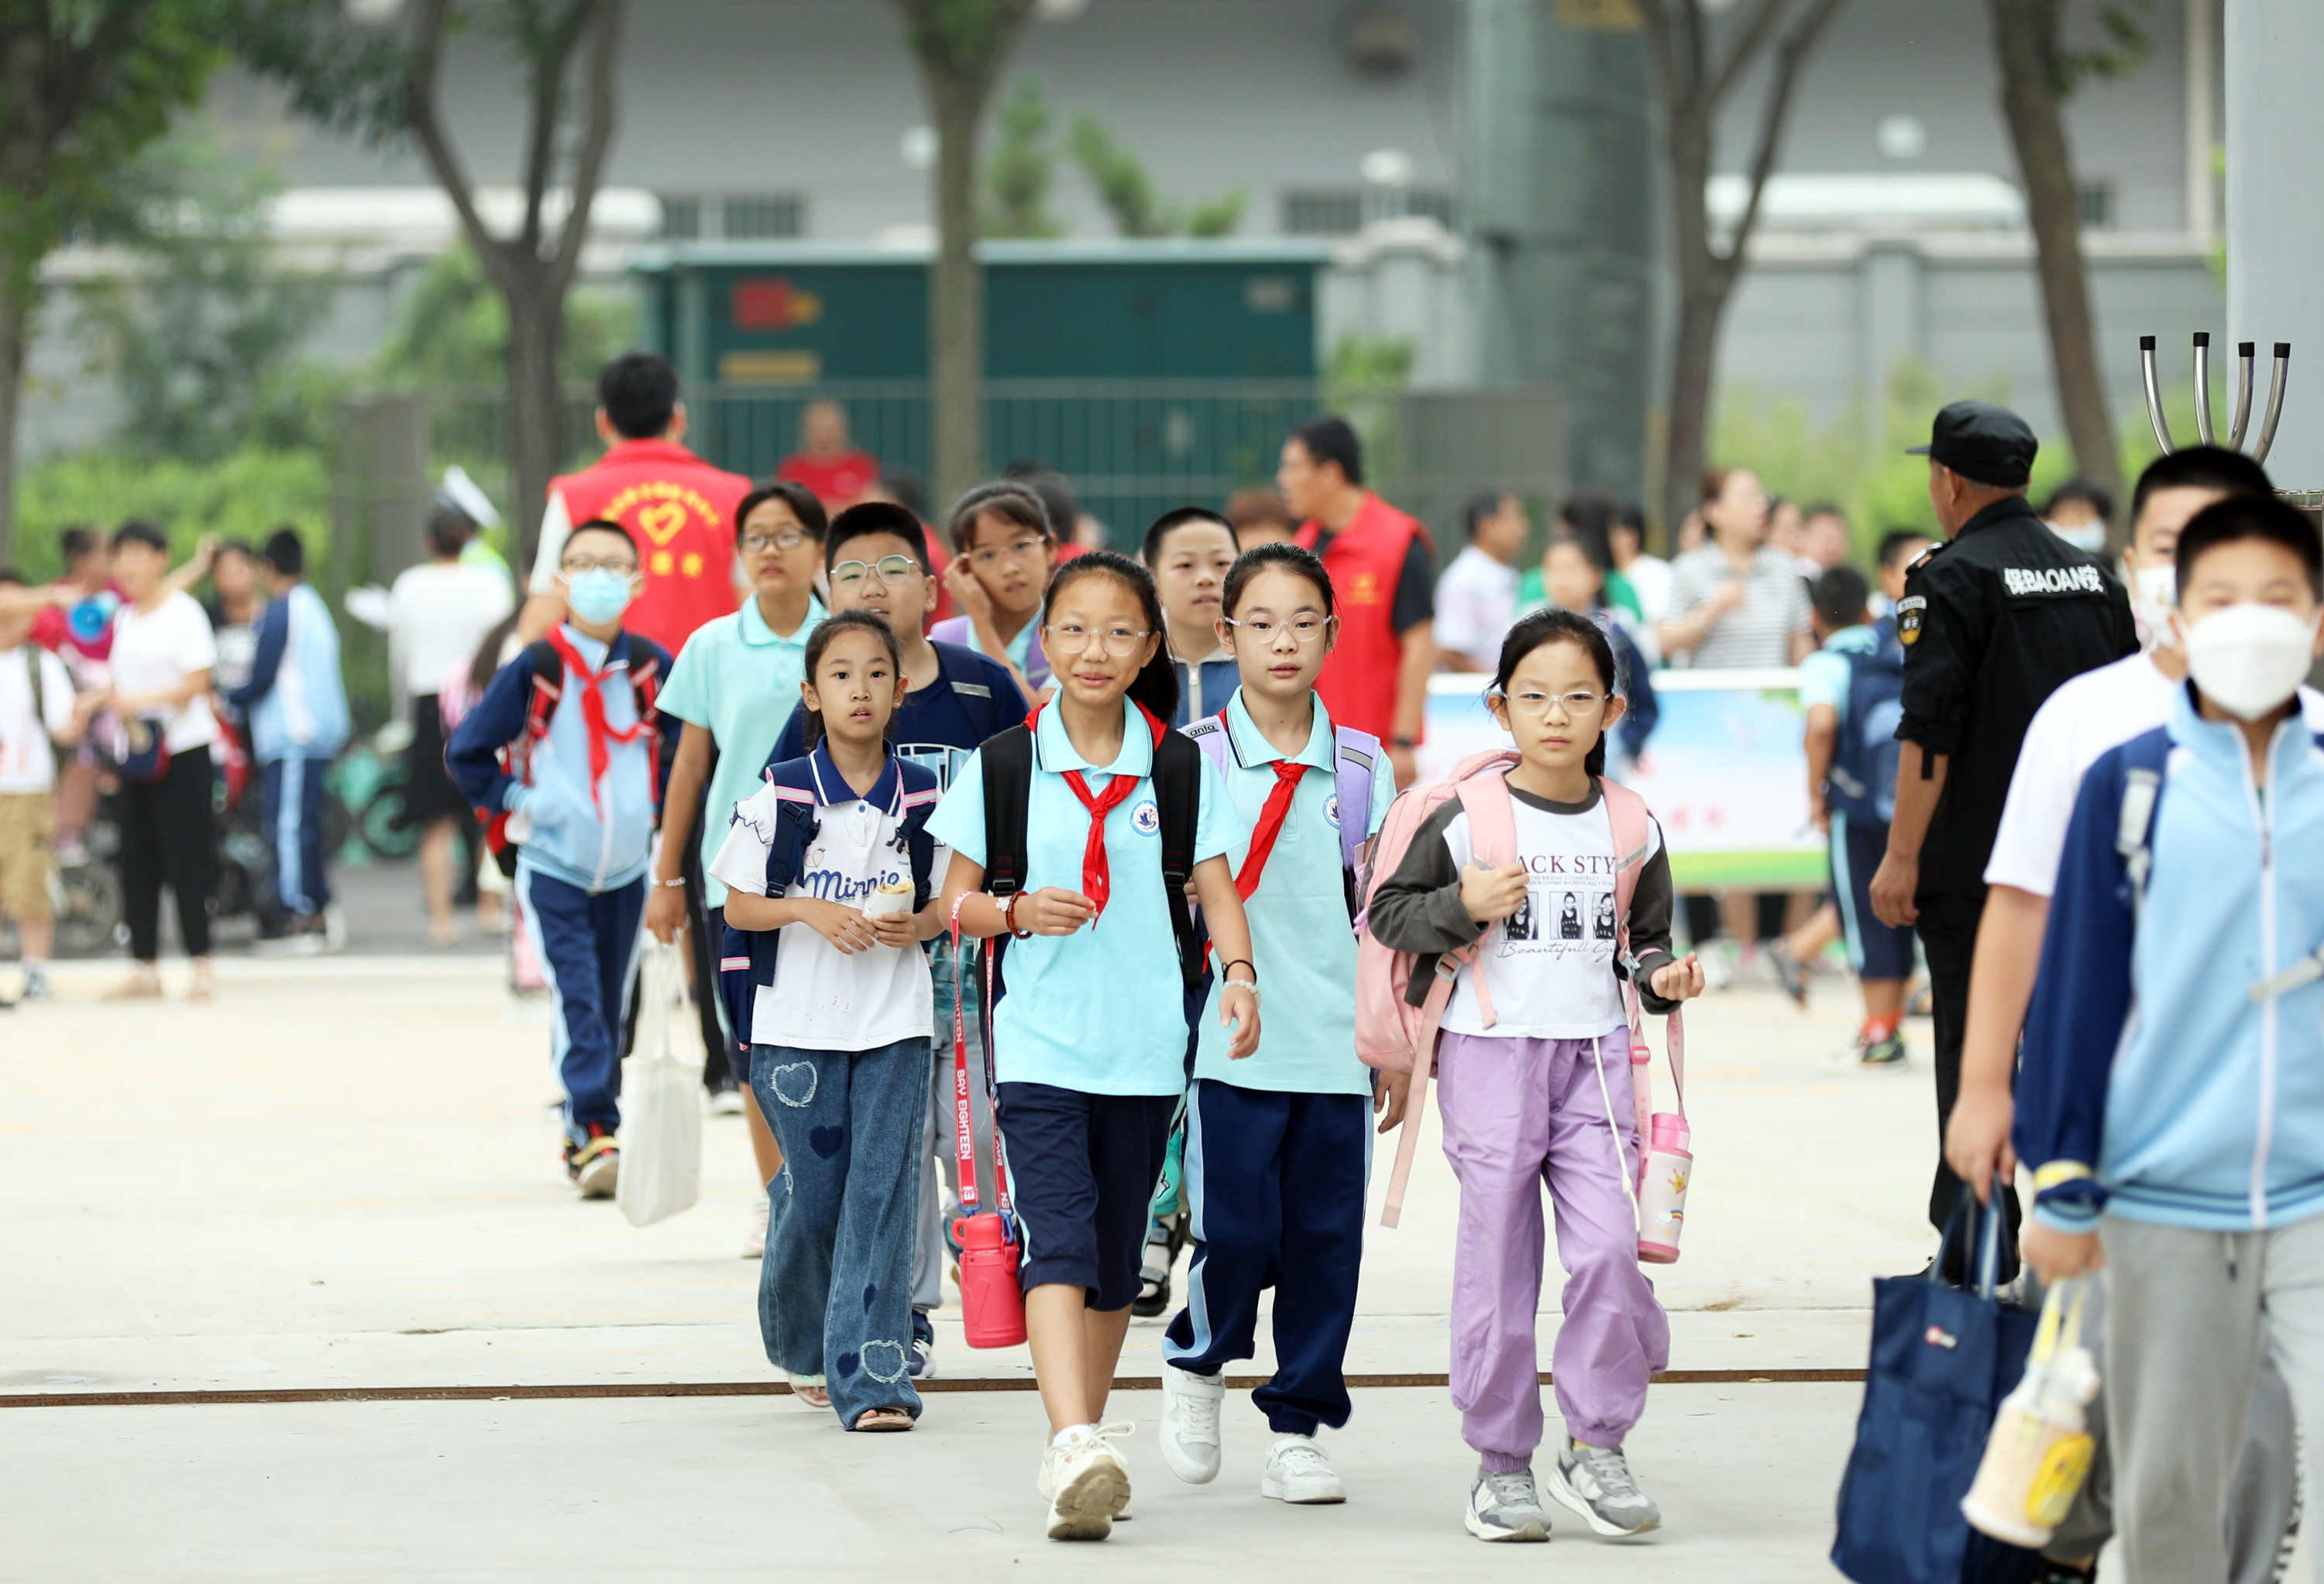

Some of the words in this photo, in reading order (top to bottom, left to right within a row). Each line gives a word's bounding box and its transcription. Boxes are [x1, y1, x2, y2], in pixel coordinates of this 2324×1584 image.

[1190, 725, 1215, 737] anta
[957, 1069, 967, 1096] BAY
[957, 1099, 971, 1160] EIGHTEEN
